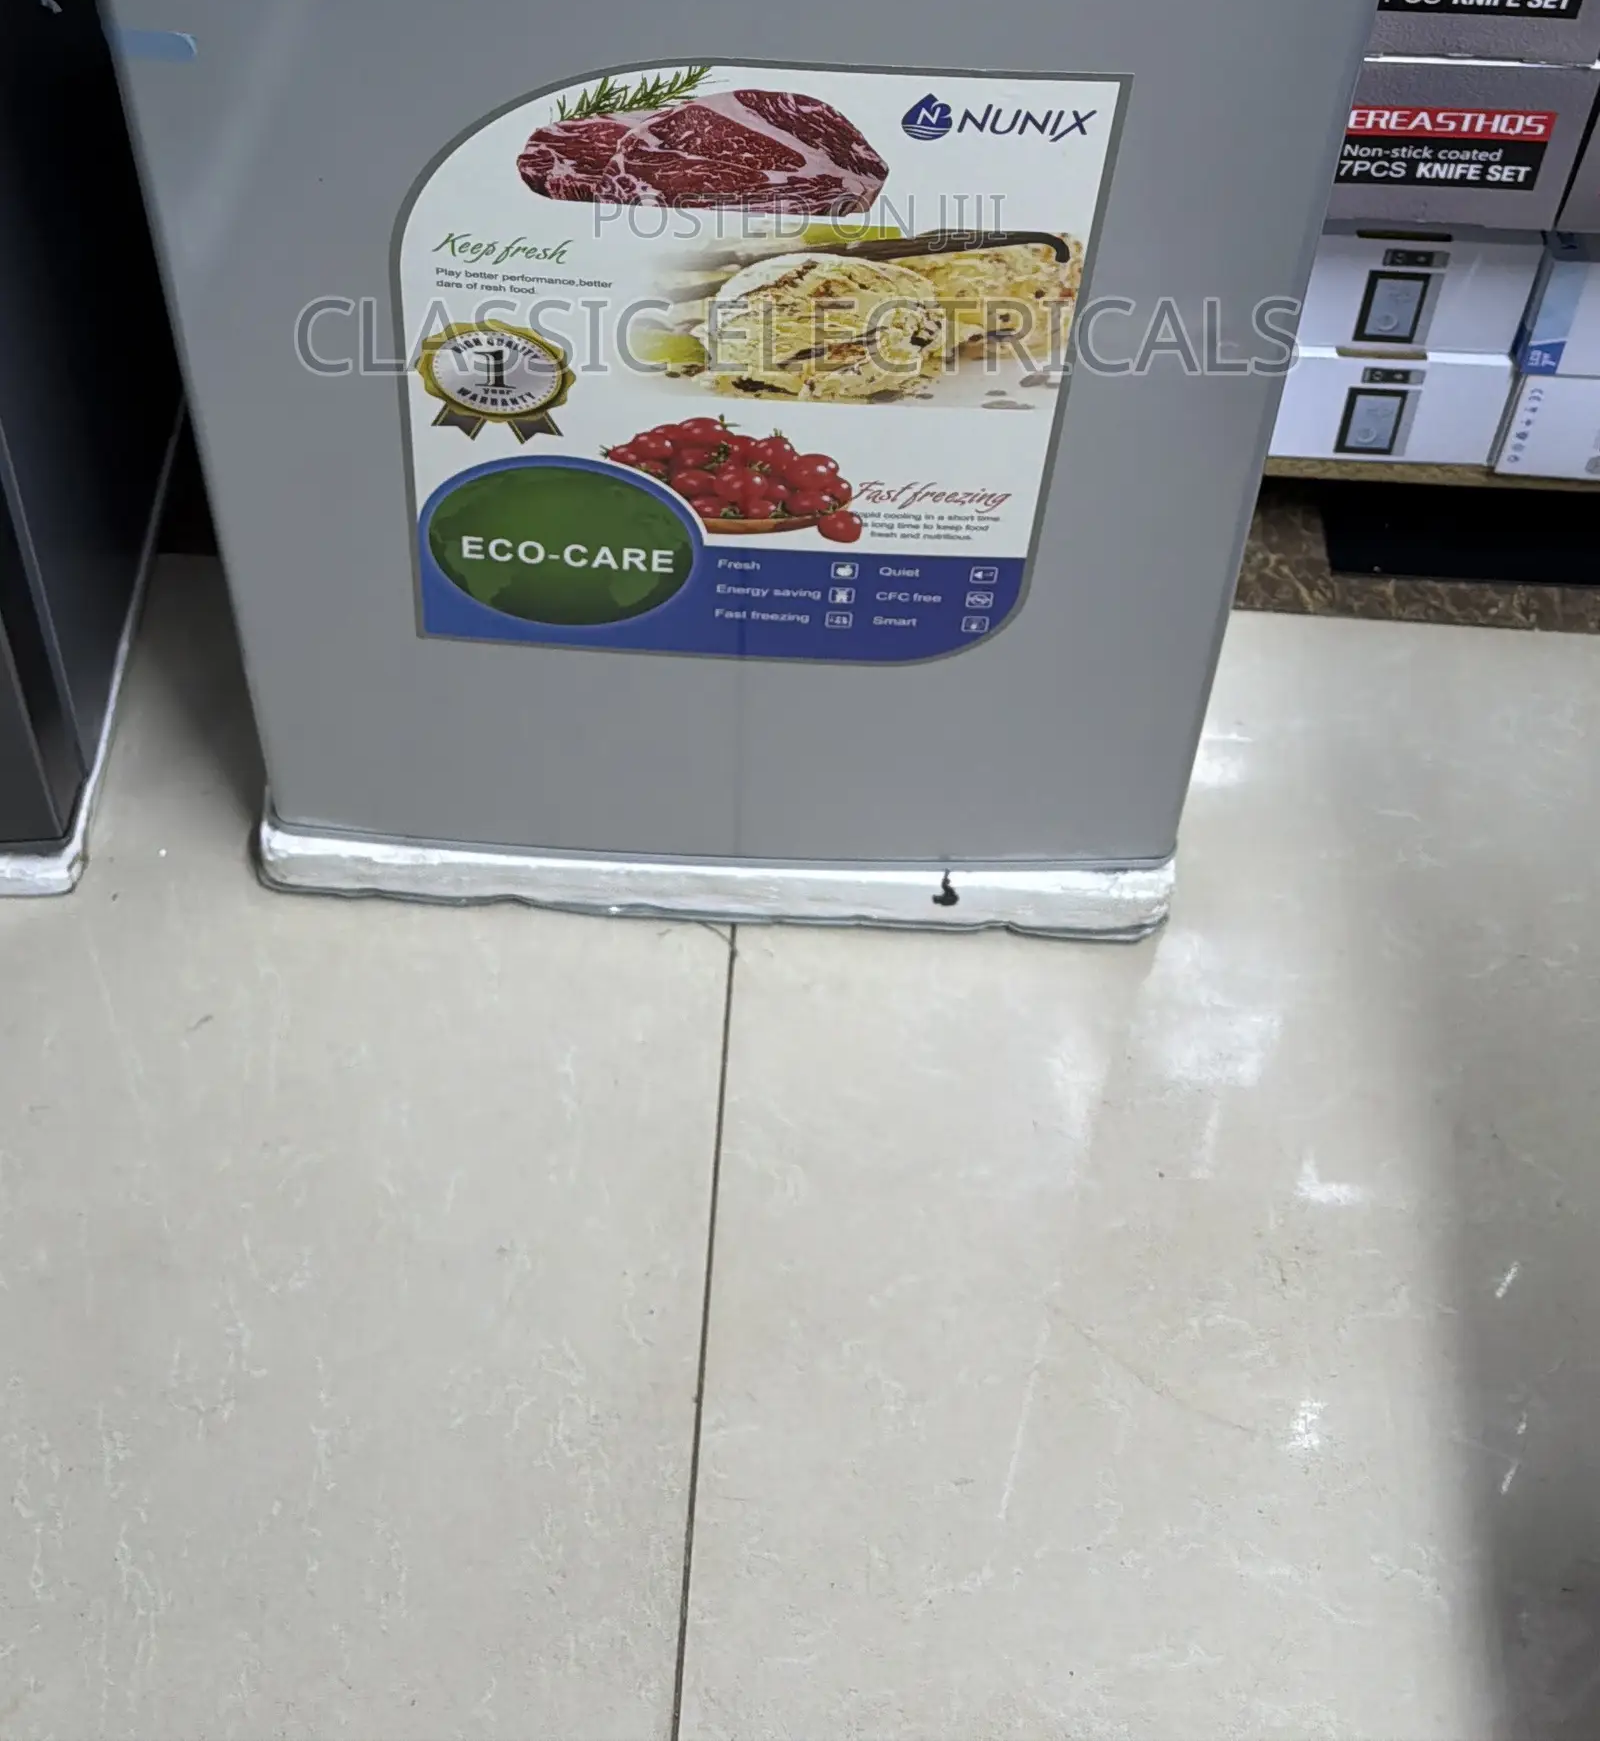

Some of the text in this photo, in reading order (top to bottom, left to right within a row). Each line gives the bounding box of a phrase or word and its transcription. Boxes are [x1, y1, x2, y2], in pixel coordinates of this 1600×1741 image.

[957, 103, 1098, 142] NUNIX
[1348, 110, 1549, 136] EREASTHQS
[1343, 144, 1503, 161] Non-stick coated
[1339, 160, 1533, 183] 7PCS KNIFE SET
[432, 233, 574, 265] Keep fresh
[435, 267, 462, 278] Play
[465, 270, 499, 281] better
[474, 350, 517, 390] 1
[853, 480, 1012, 513] Fast freezing
[461, 535, 674, 573] ECO-CARE
[717, 559, 761, 570] Fresh
[879, 566, 920, 578] Quiet
[715, 584, 822, 600] Energy saving
[875, 591, 943, 603] CFC free
[714, 609, 810, 624] Fast freezing
[872, 616, 918, 628] Smart
